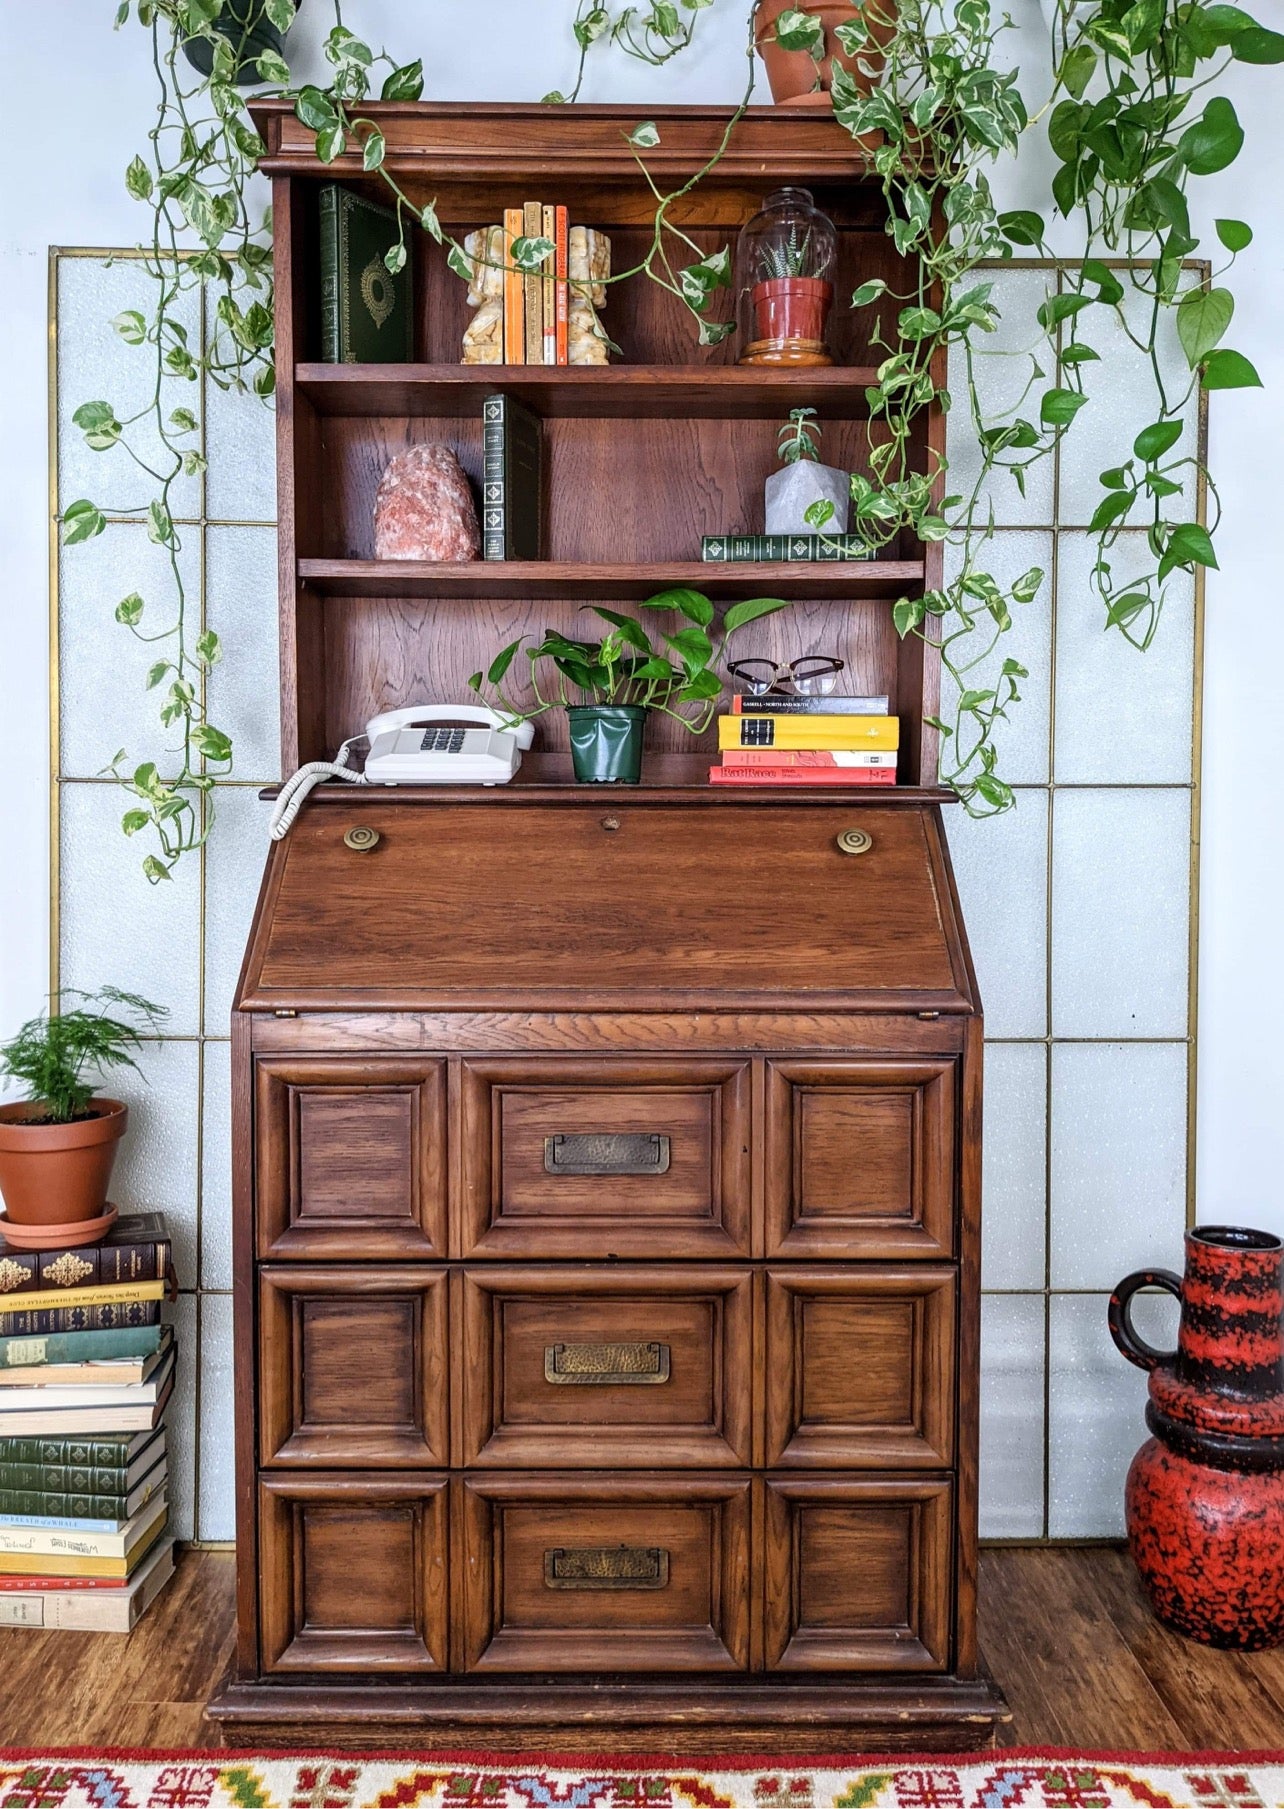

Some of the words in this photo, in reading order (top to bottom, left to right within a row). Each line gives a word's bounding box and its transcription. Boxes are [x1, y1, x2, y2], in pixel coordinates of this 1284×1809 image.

[82, 1291, 96, 1302] from
[124, 1291, 140, 1299] Deep
[10, 1515, 39, 1525] BREATH
[51, 1519, 77, 1528] WHALE
